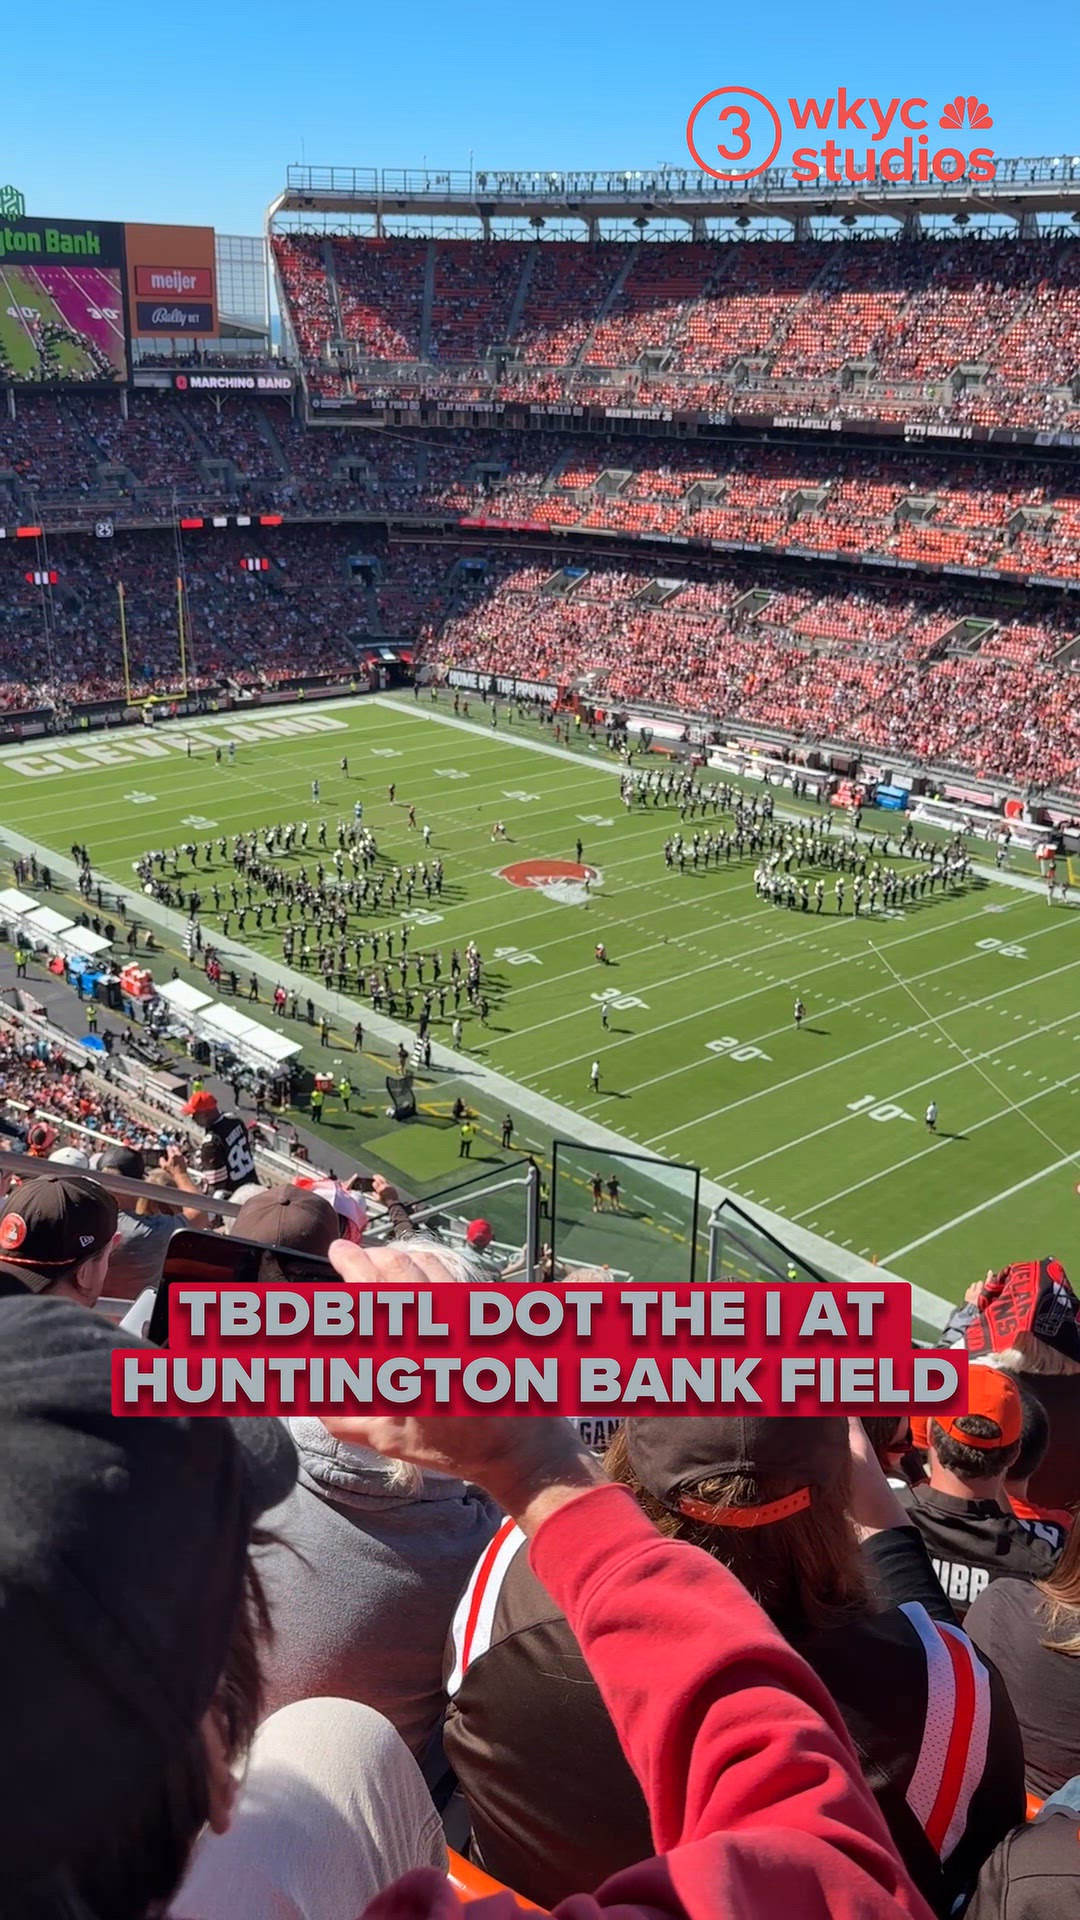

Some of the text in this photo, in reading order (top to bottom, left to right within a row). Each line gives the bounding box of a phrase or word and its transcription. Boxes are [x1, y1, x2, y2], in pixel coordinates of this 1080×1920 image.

[45, 228, 101, 255] Bank
[151, 270, 197, 293] meijer
[151, 307, 187, 327] Bally
[190, 375, 254, 390] MARCHING
[257, 376, 291, 391] BAND
[437, 401, 505, 413] CLAY MATTHEWS 57
[605, 408, 632, 419] MARION
[632, 409, 661, 421] MOTLEY
[773, 418, 798, 428] DANTE
[798, 419, 829, 430] LAVELLI
[903, 424, 927, 436] OTTO
[927, 426, 961, 438] GRAHAM
[861, 557, 917, 570] MARCHING BAND
[943, 565, 1001, 580] MARCHING BAND
[1028, 576, 1067, 589] MARCHING
[449, 669, 478, 688] HOME
[478, 675, 491, 692] OF
[496, 678, 514, 696] THE
[3, 715, 349, 777] CLEVELAND
[493, 946, 540, 965] 40
[591, 988, 643, 1010] 30
[704, 1036, 764, 1062] 20
[846, 1094, 905, 1122] 10
[228, 1136, 254, 1181] 95
